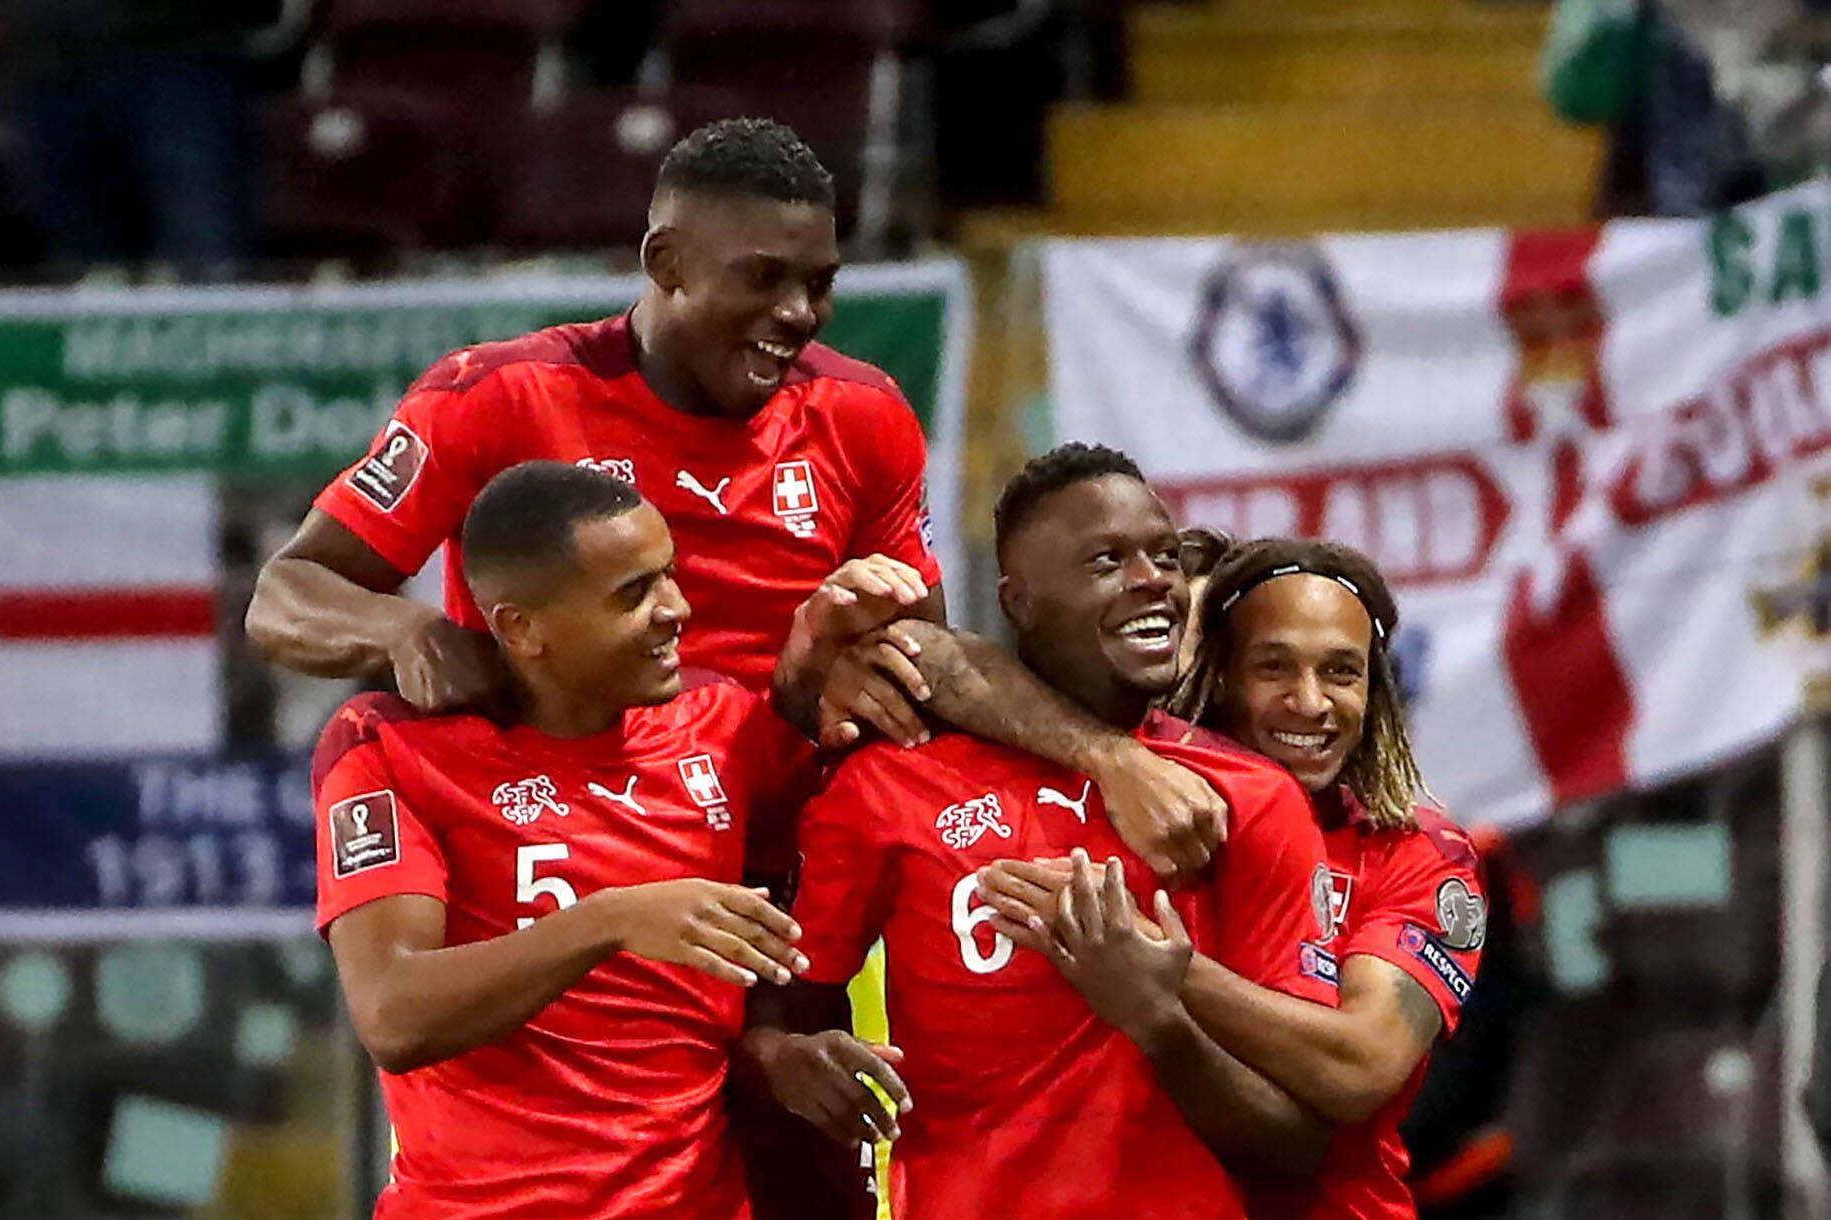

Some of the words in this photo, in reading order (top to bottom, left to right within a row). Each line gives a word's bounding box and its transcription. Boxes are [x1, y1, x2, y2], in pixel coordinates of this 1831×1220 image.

[1, 386, 226, 460] Peter
[516, 843, 578, 931] 5
[951, 872, 1014, 974] 6
[1424, 943, 1473, 997] RESPECT
